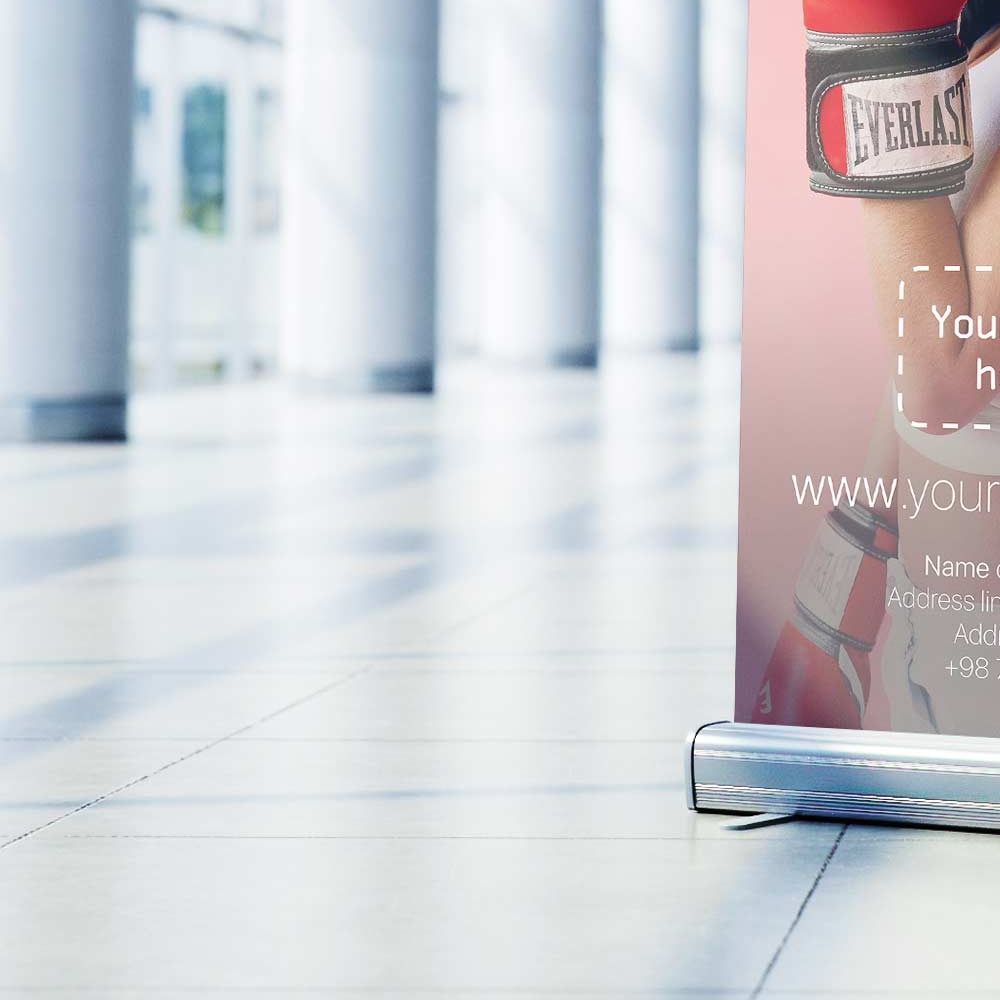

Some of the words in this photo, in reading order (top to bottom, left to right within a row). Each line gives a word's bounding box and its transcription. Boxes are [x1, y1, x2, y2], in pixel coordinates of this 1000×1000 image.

[847, 73, 972, 168] EVERLAST
[924, 554, 989, 579] Name
[887, 586, 976, 612] Address
[945, 656, 990, 680] +98
